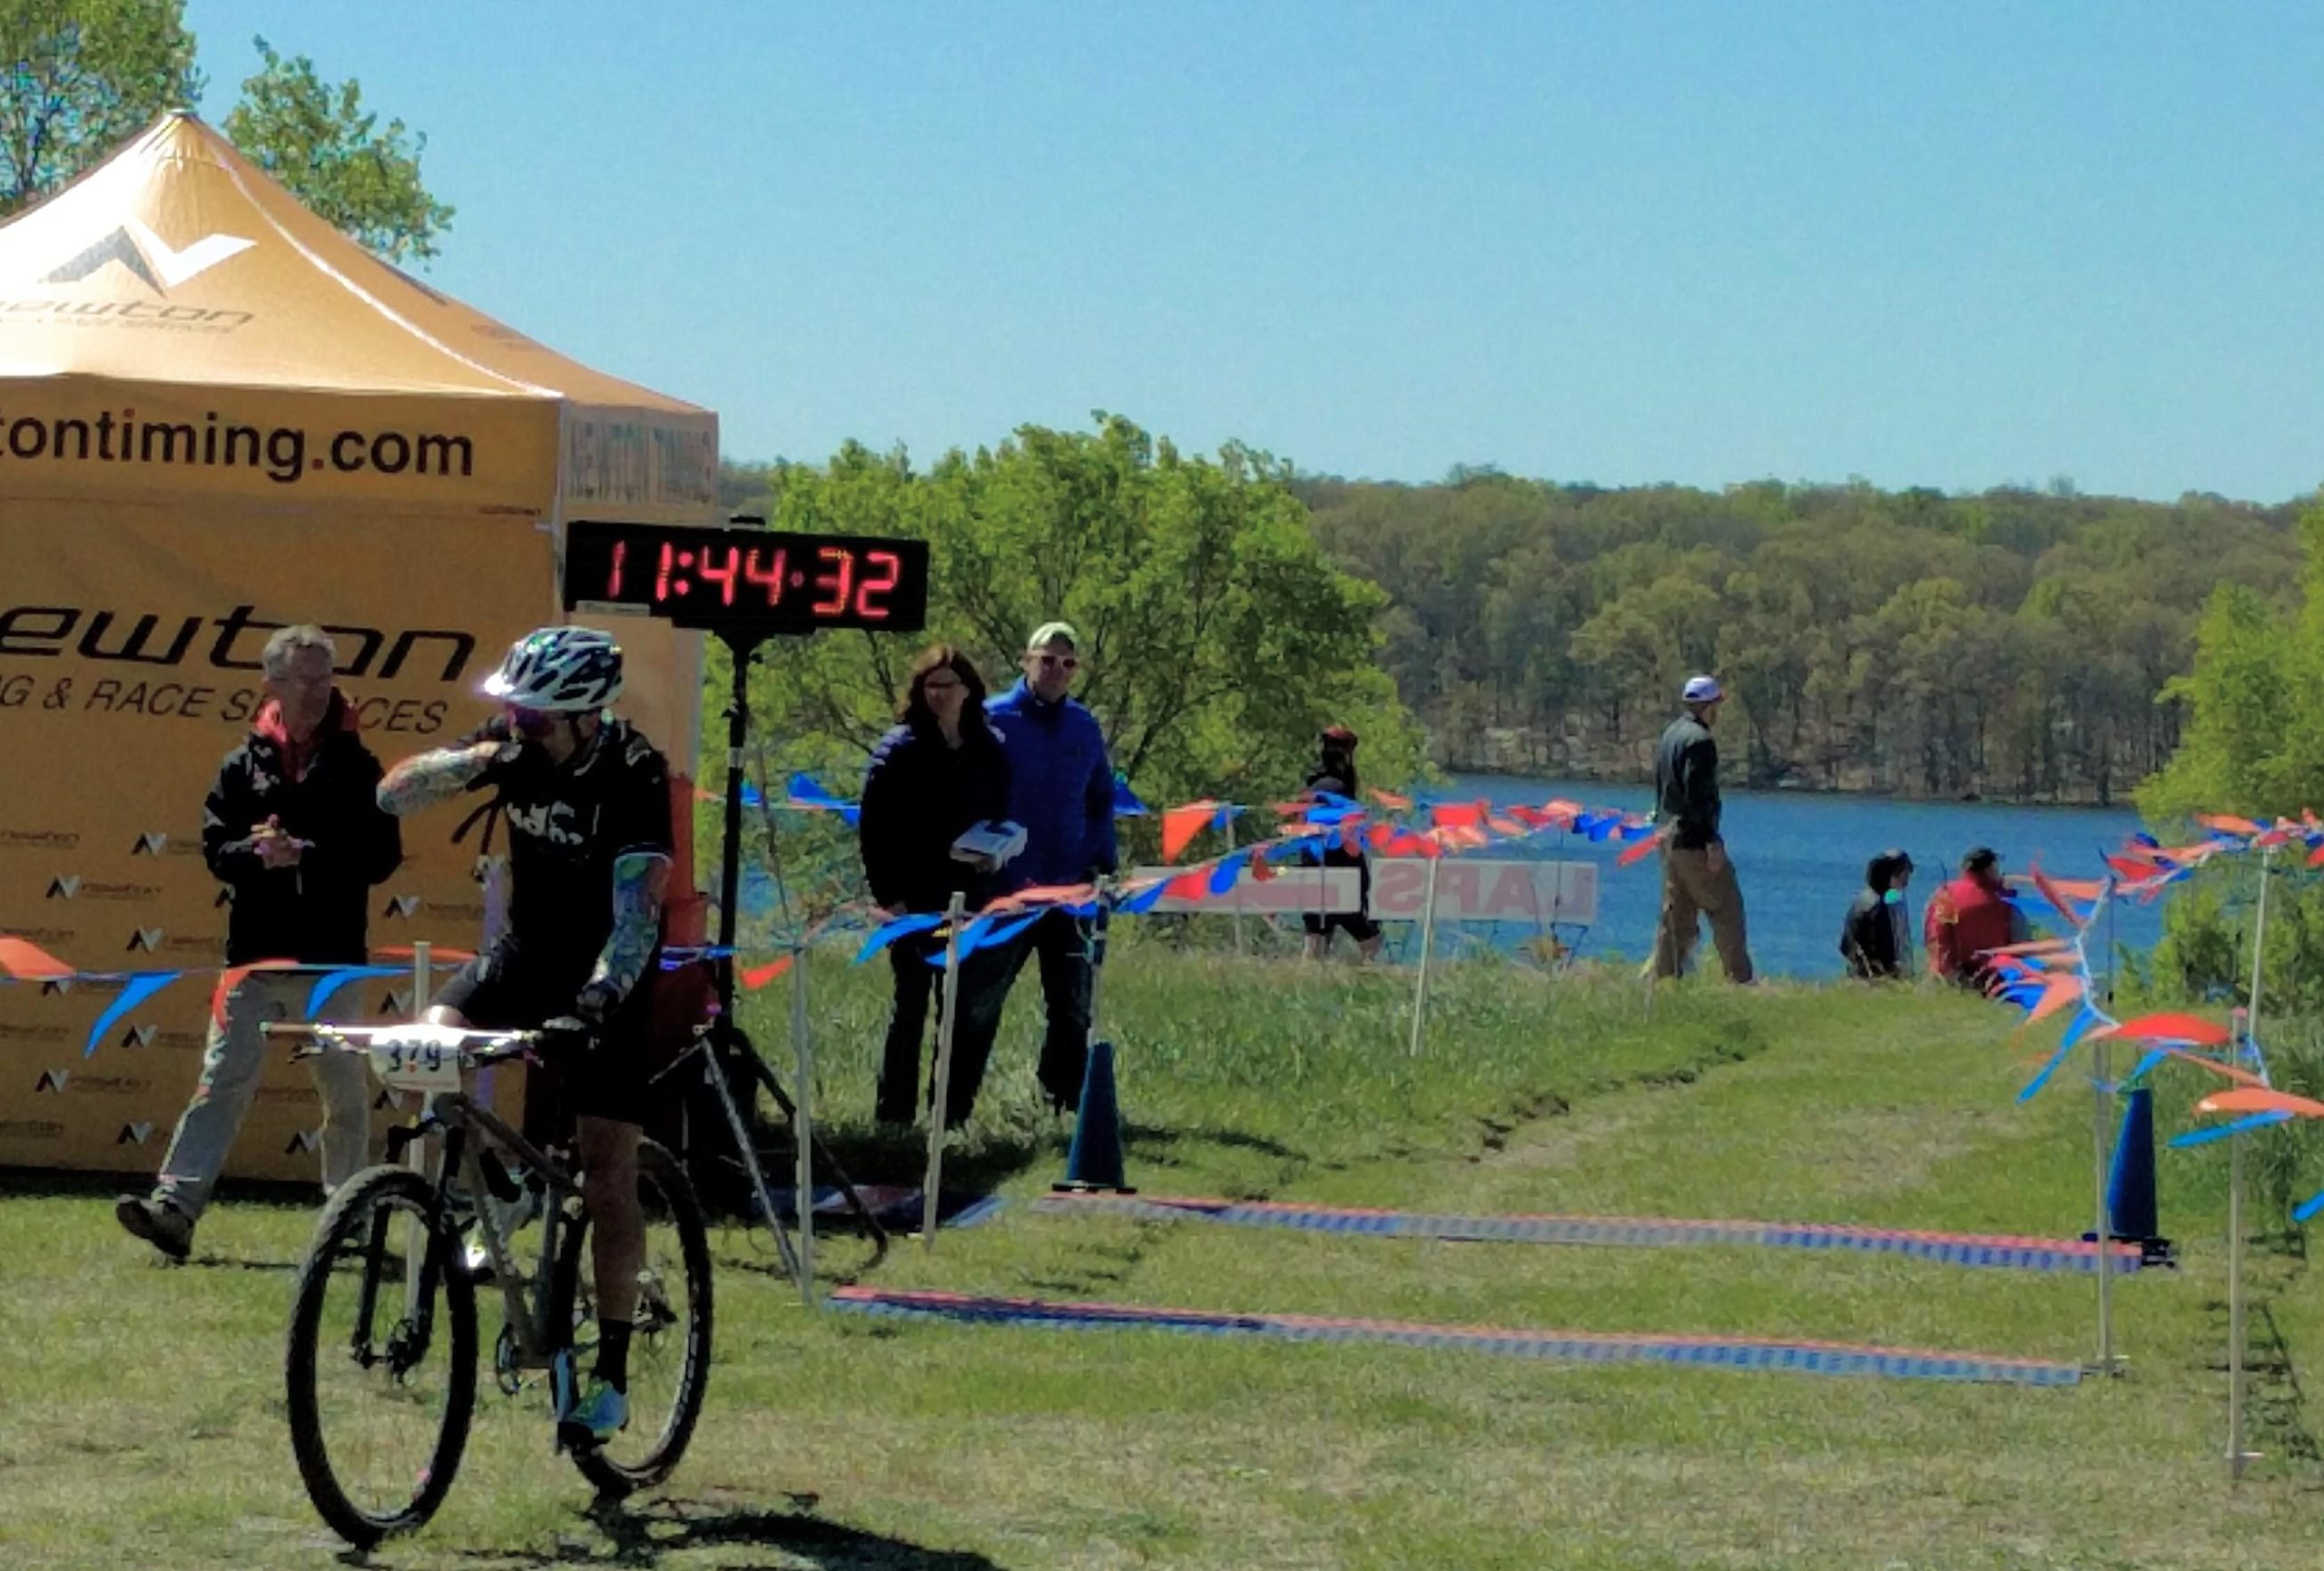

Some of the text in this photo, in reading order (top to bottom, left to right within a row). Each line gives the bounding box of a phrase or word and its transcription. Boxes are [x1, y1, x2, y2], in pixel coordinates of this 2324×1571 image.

[0, 300, 254, 324] ewton
[0, 407, 473, 483] ontiming.com
[0, 674, 448, 734] G & RACE SCES
